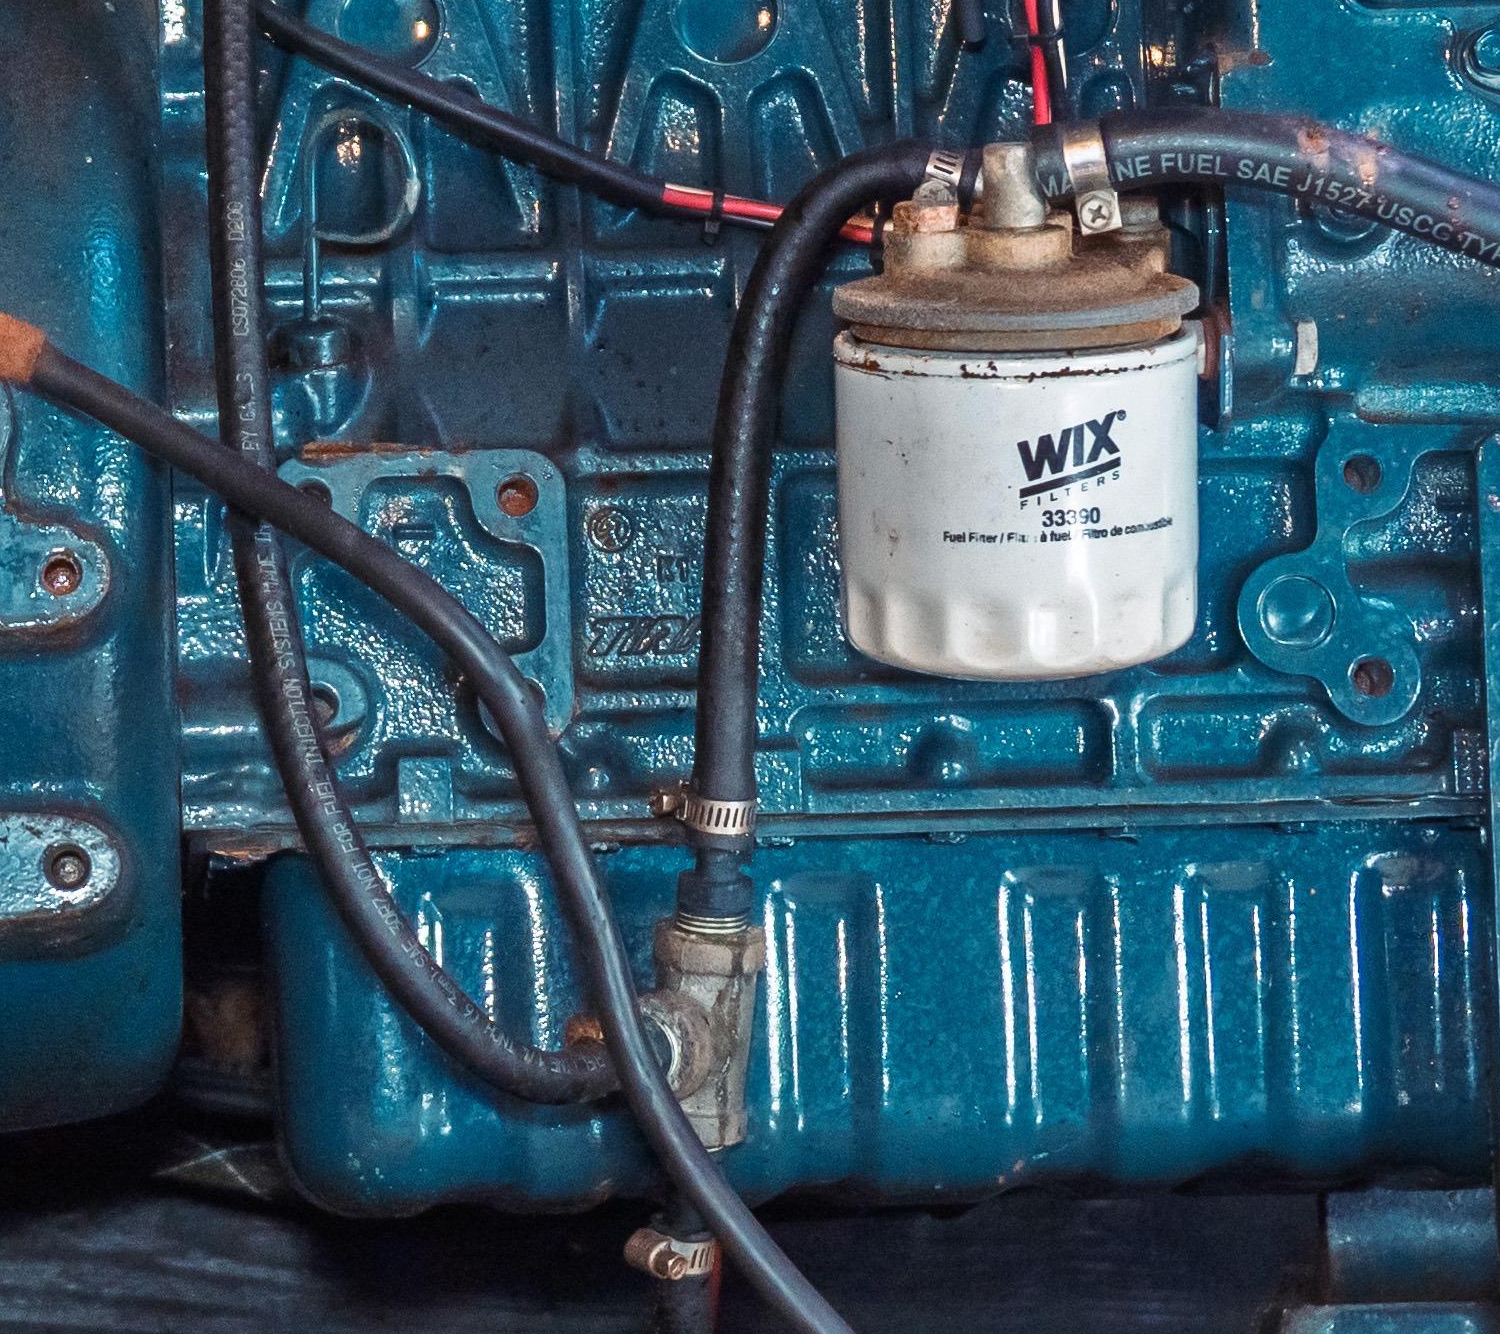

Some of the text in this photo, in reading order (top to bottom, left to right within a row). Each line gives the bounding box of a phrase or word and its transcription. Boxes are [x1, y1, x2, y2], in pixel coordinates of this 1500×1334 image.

[1160, 153, 1228, 176] FUEL
[1236, 159, 1292, 187] SAE
[1296, 175, 1372, 207] J1527
[239, 430, 260, 450] BY
[1017, 411, 1121, 482] WIX
[1020, 470, 1120, 510] FILTERS
[943, 531, 966, 543] Fuel
[1050, 530, 1071, 542] fuel
[1110, 525, 1123, 537] de
[1042, 507, 1100, 527] 33390
[257, 552, 280, 593] MADE
[265, 600, 295, 670] SYSTEMS
[282, 677, 323, 767] INJECTION
[315, 774, 343, 815] FUEL
[332, 823, 359, 853] FOR
[351, 861, 379, 890] NOT
[402, 936, 428, 967] SAE
